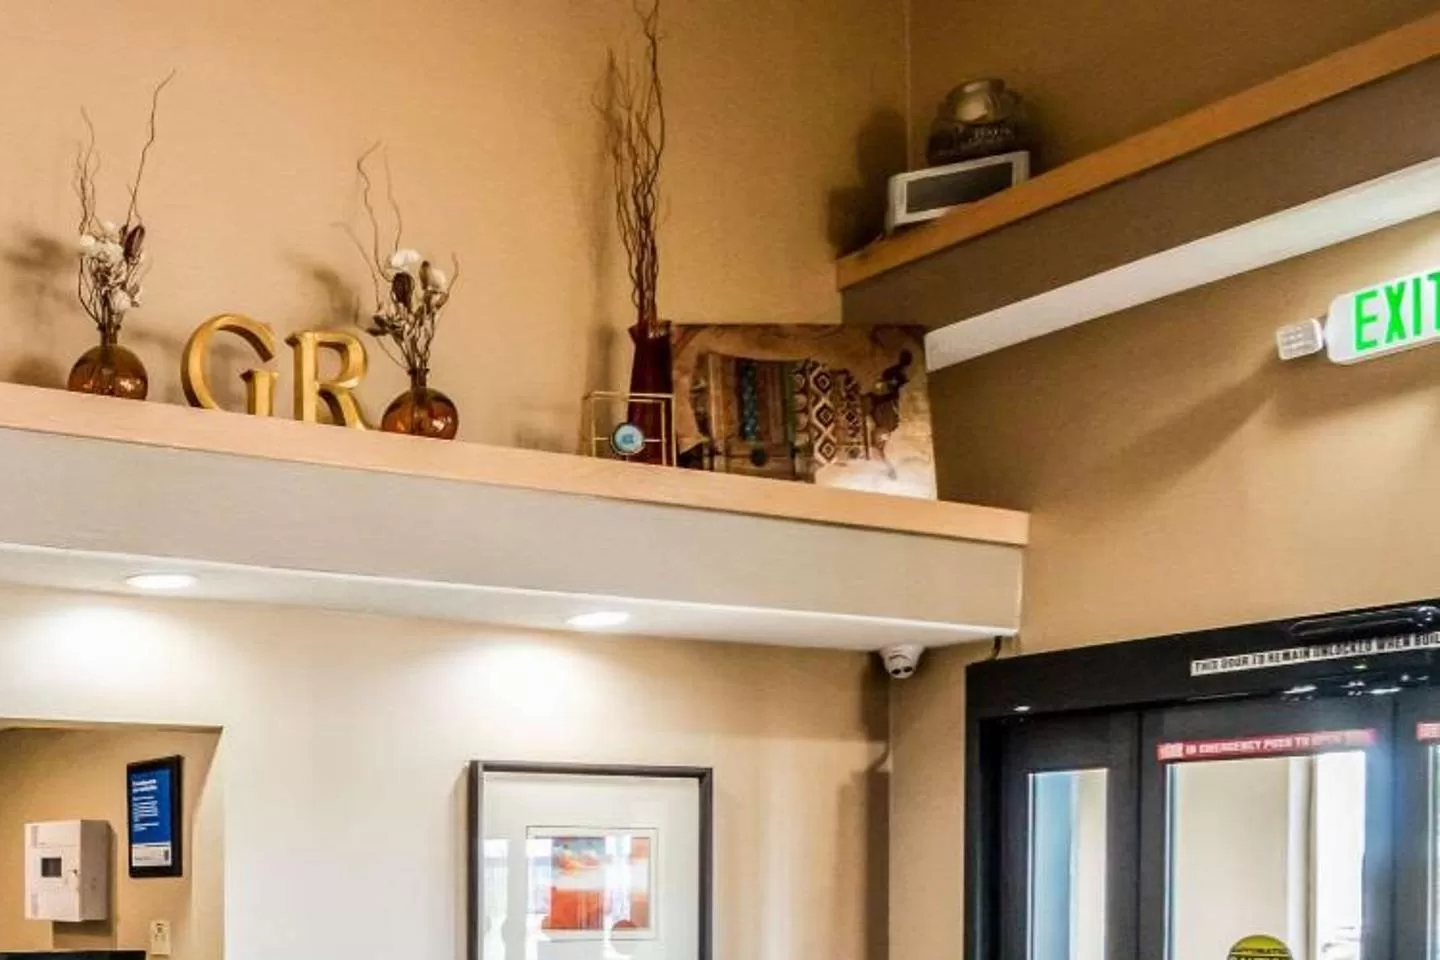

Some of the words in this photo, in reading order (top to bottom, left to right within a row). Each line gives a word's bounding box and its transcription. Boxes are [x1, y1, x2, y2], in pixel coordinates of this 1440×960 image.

[1355, 271, 1440, 351] EXIT
[1194, 659, 1219, 673] THIS
[1220, 655, 1248, 669] DOOR
[1251, 653, 1265, 666] TO
[1266, 648, 1310, 664] REMAIN
